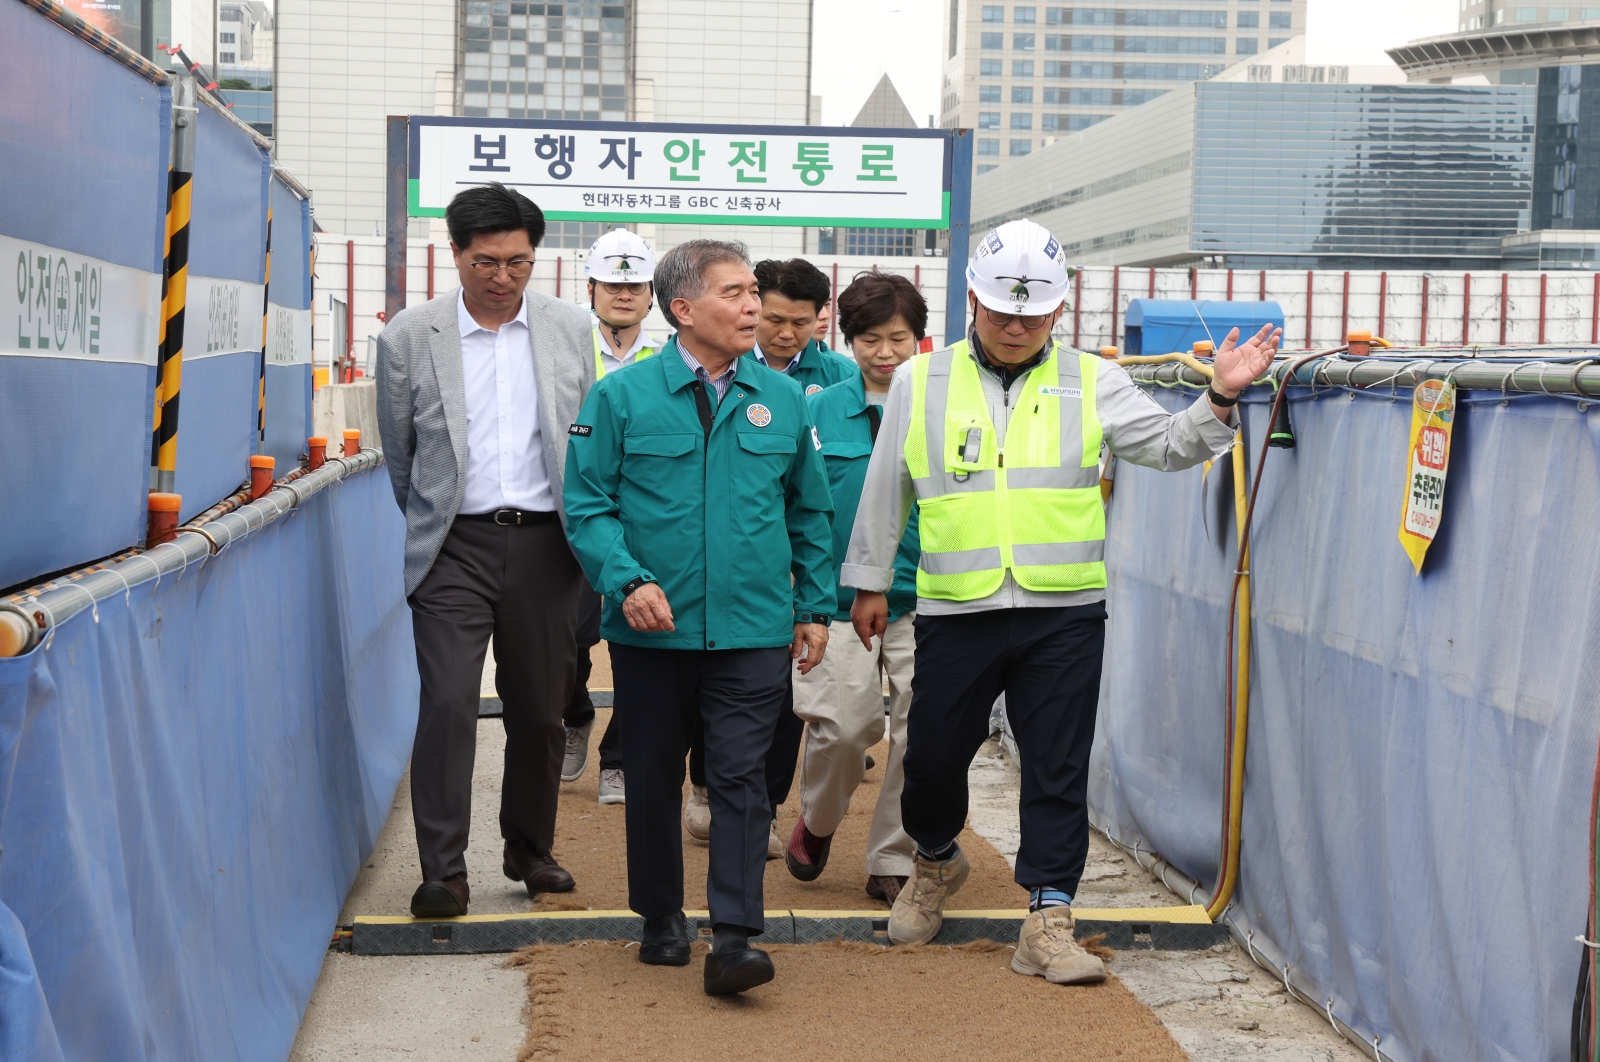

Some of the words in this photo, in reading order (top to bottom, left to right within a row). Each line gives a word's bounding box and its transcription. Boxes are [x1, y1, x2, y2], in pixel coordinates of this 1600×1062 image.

[468, 133, 643, 181] 보행자
[662, 138, 899, 187] 안전통로
[582, 192, 682, 208] 현대자동차그룹
[687, 195, 719, 208] GBC
[725, 196, 782, 211] 신축공사
[16, 249, 52, 349] 안전
[72, 262, 102, 354] 제일
[1050, 387, 1081, 395] HYUNDAI
